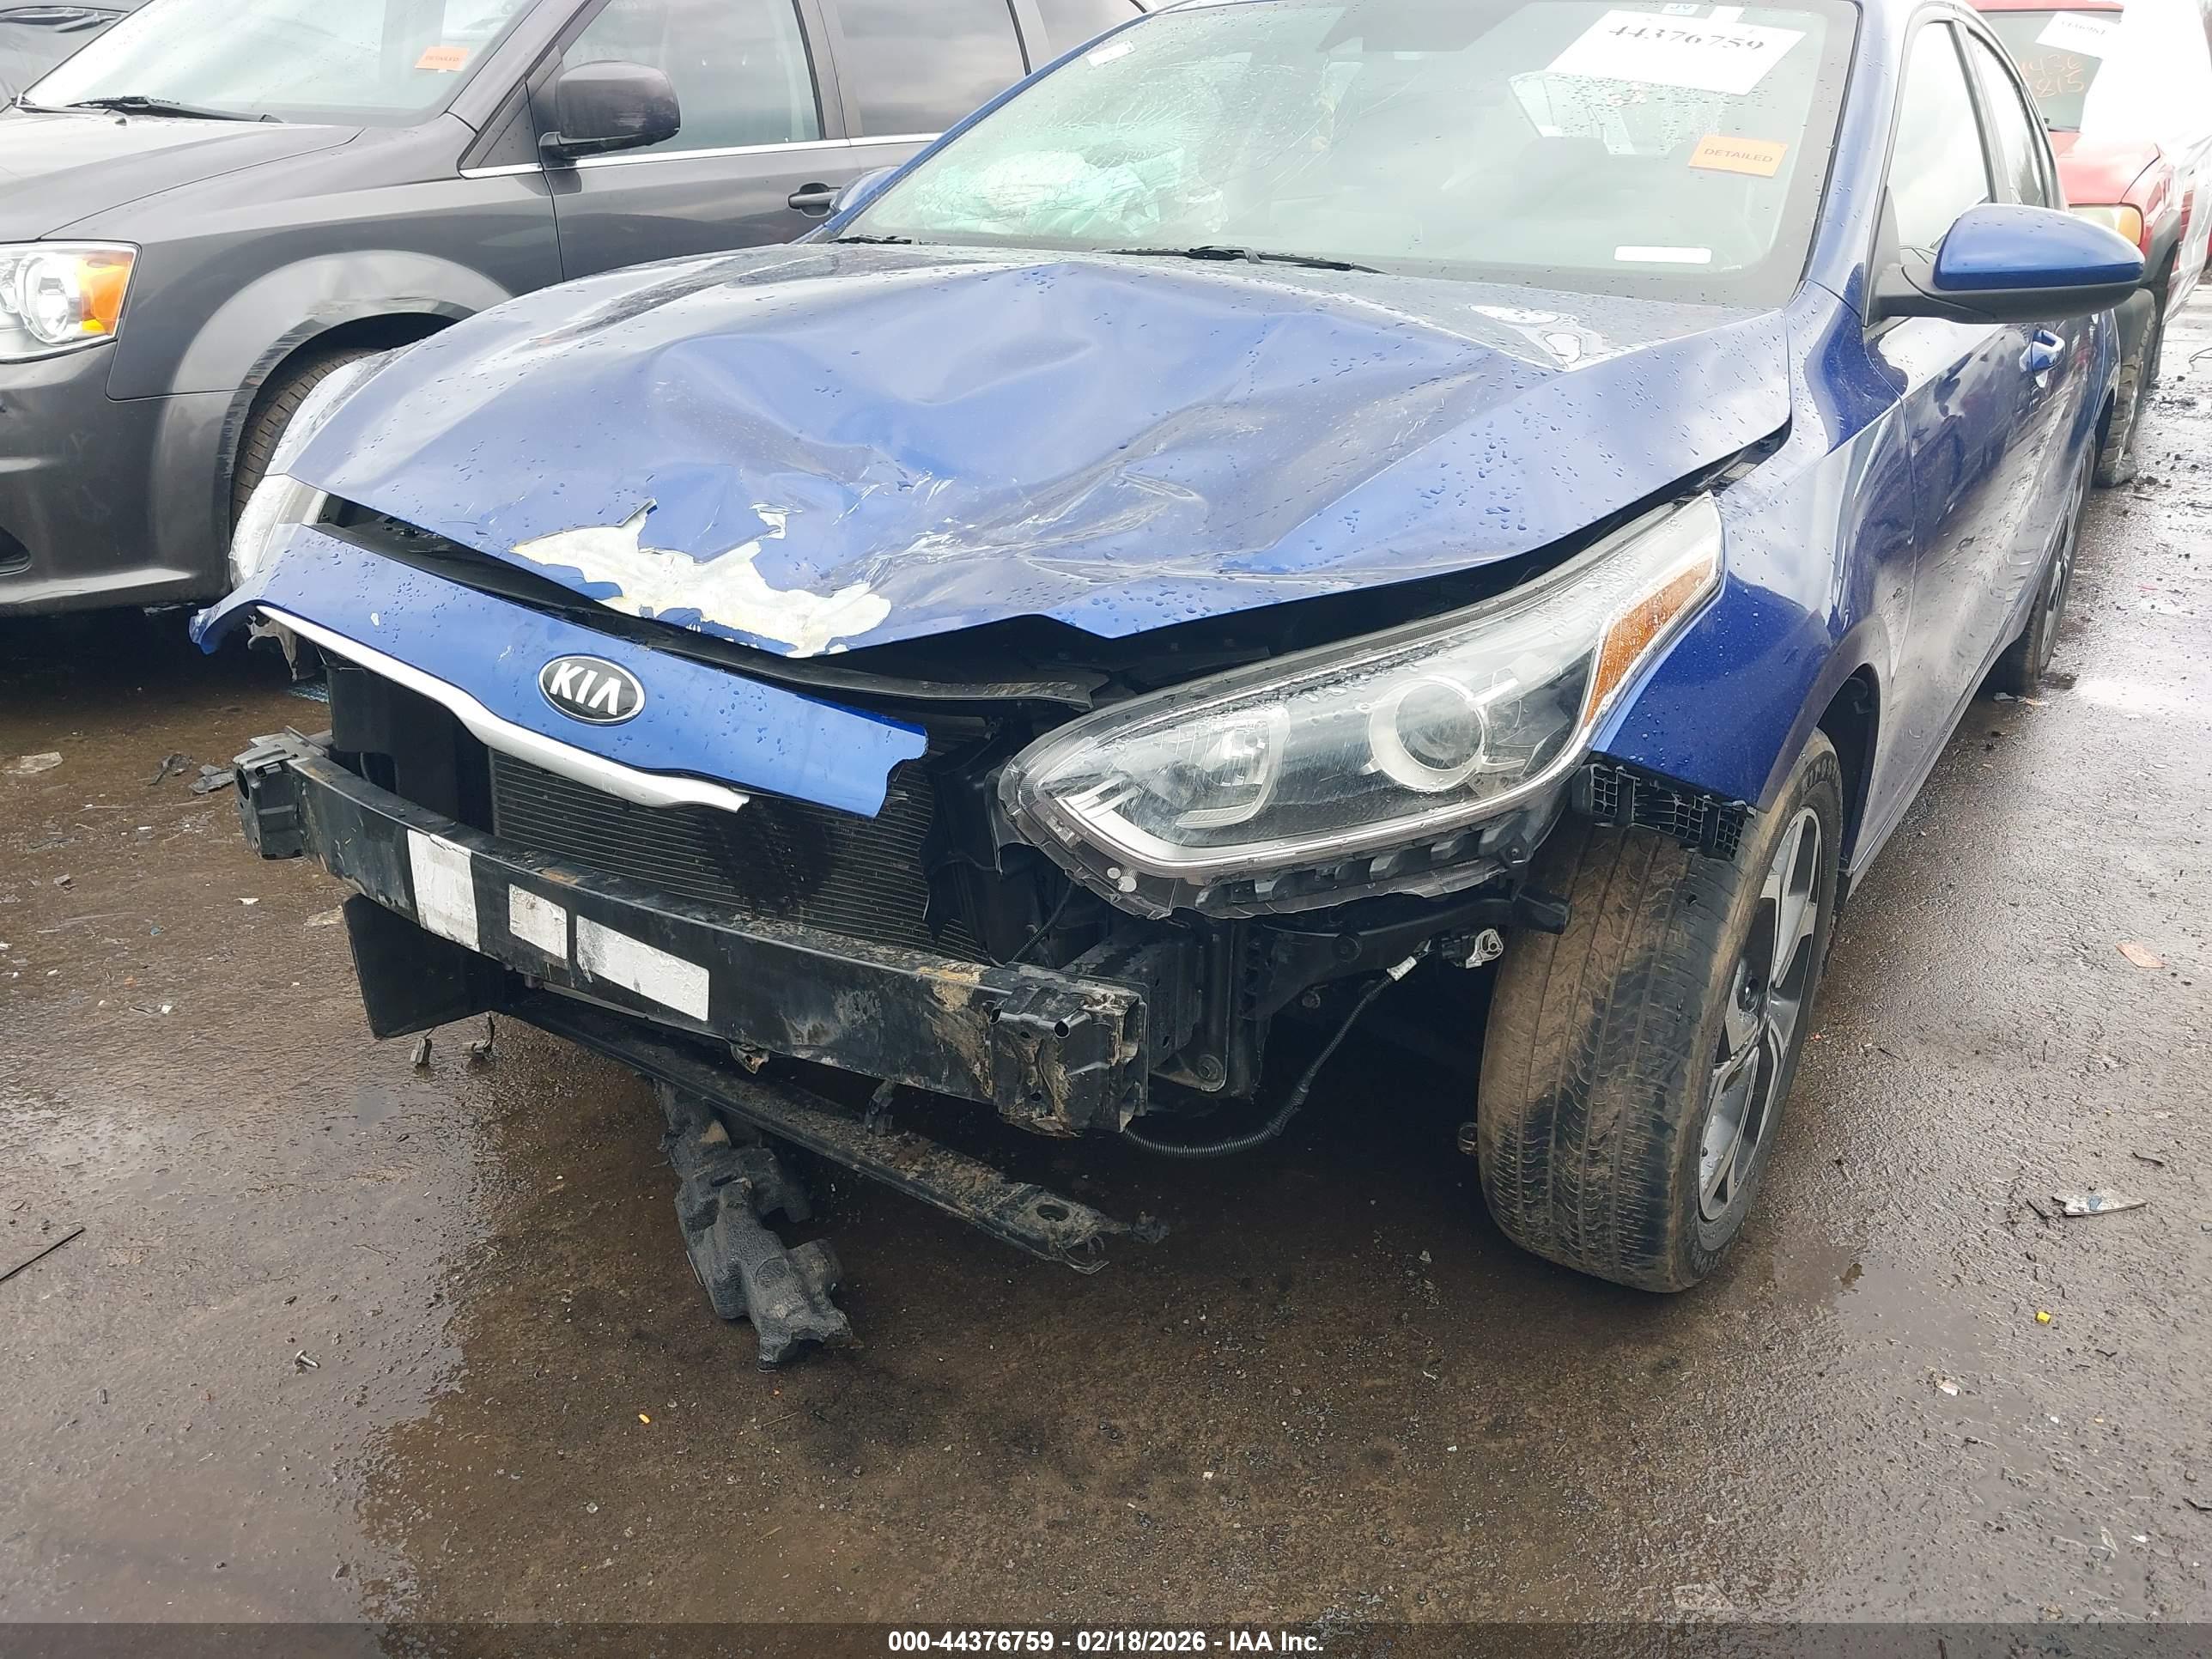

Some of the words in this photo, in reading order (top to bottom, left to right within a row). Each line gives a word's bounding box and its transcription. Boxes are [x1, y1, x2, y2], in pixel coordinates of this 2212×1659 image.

[1608, 26, 1765, 50] 44376759
[1704, 148, 1773, 162] DETAILED
[550, 661, 622, 716] KIA
